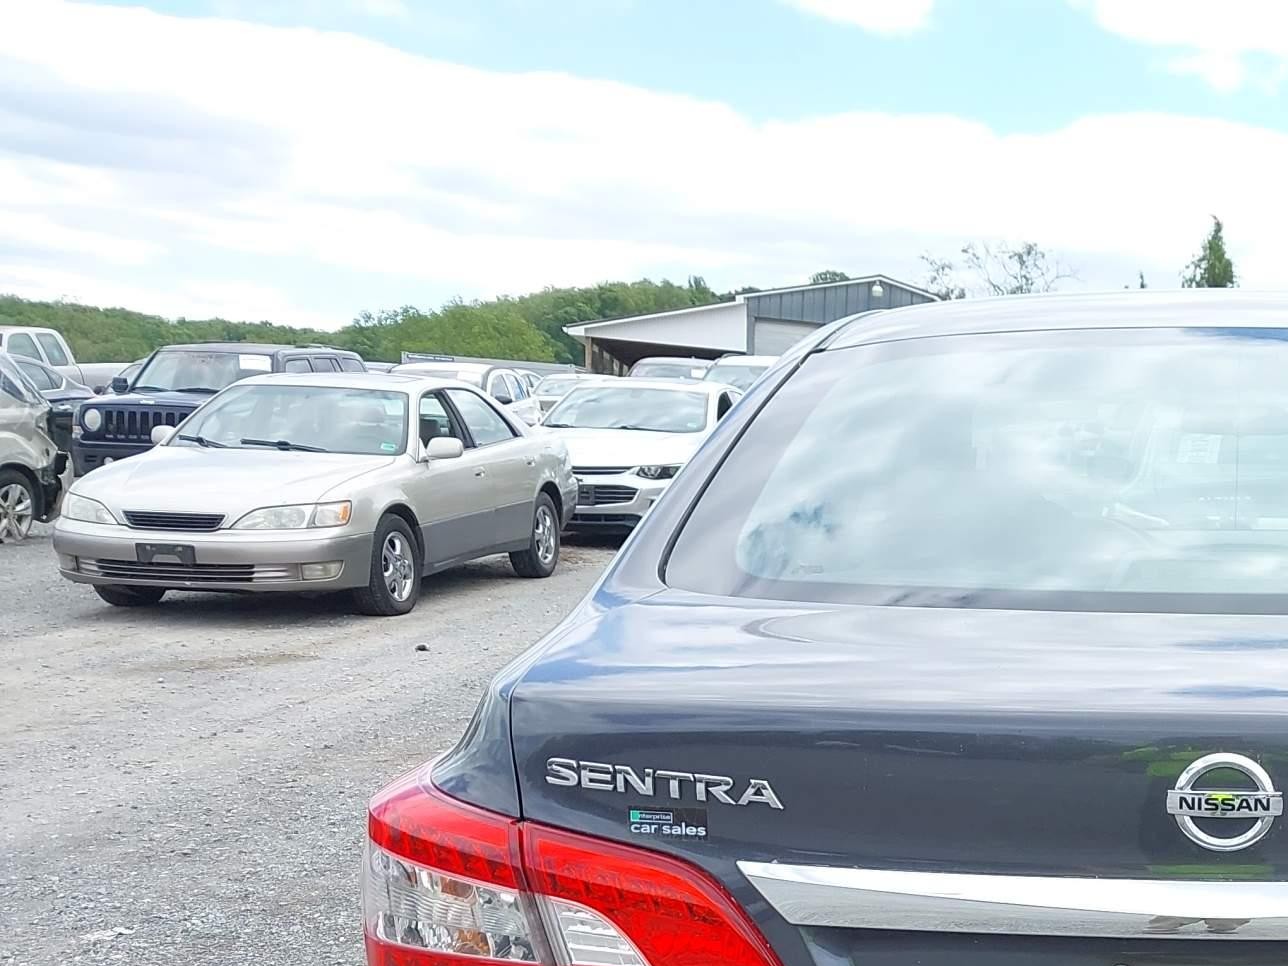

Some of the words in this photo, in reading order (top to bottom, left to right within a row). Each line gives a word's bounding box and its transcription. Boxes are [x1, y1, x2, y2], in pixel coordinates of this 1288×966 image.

[545, 757, 785, 811] SENTRA
[1178, 795, 1272, 813] NISSAN
[631, 811, 671, 822] nterprise
[630, 823, 658, 834] car
[662, 822, 707, 837] sales
